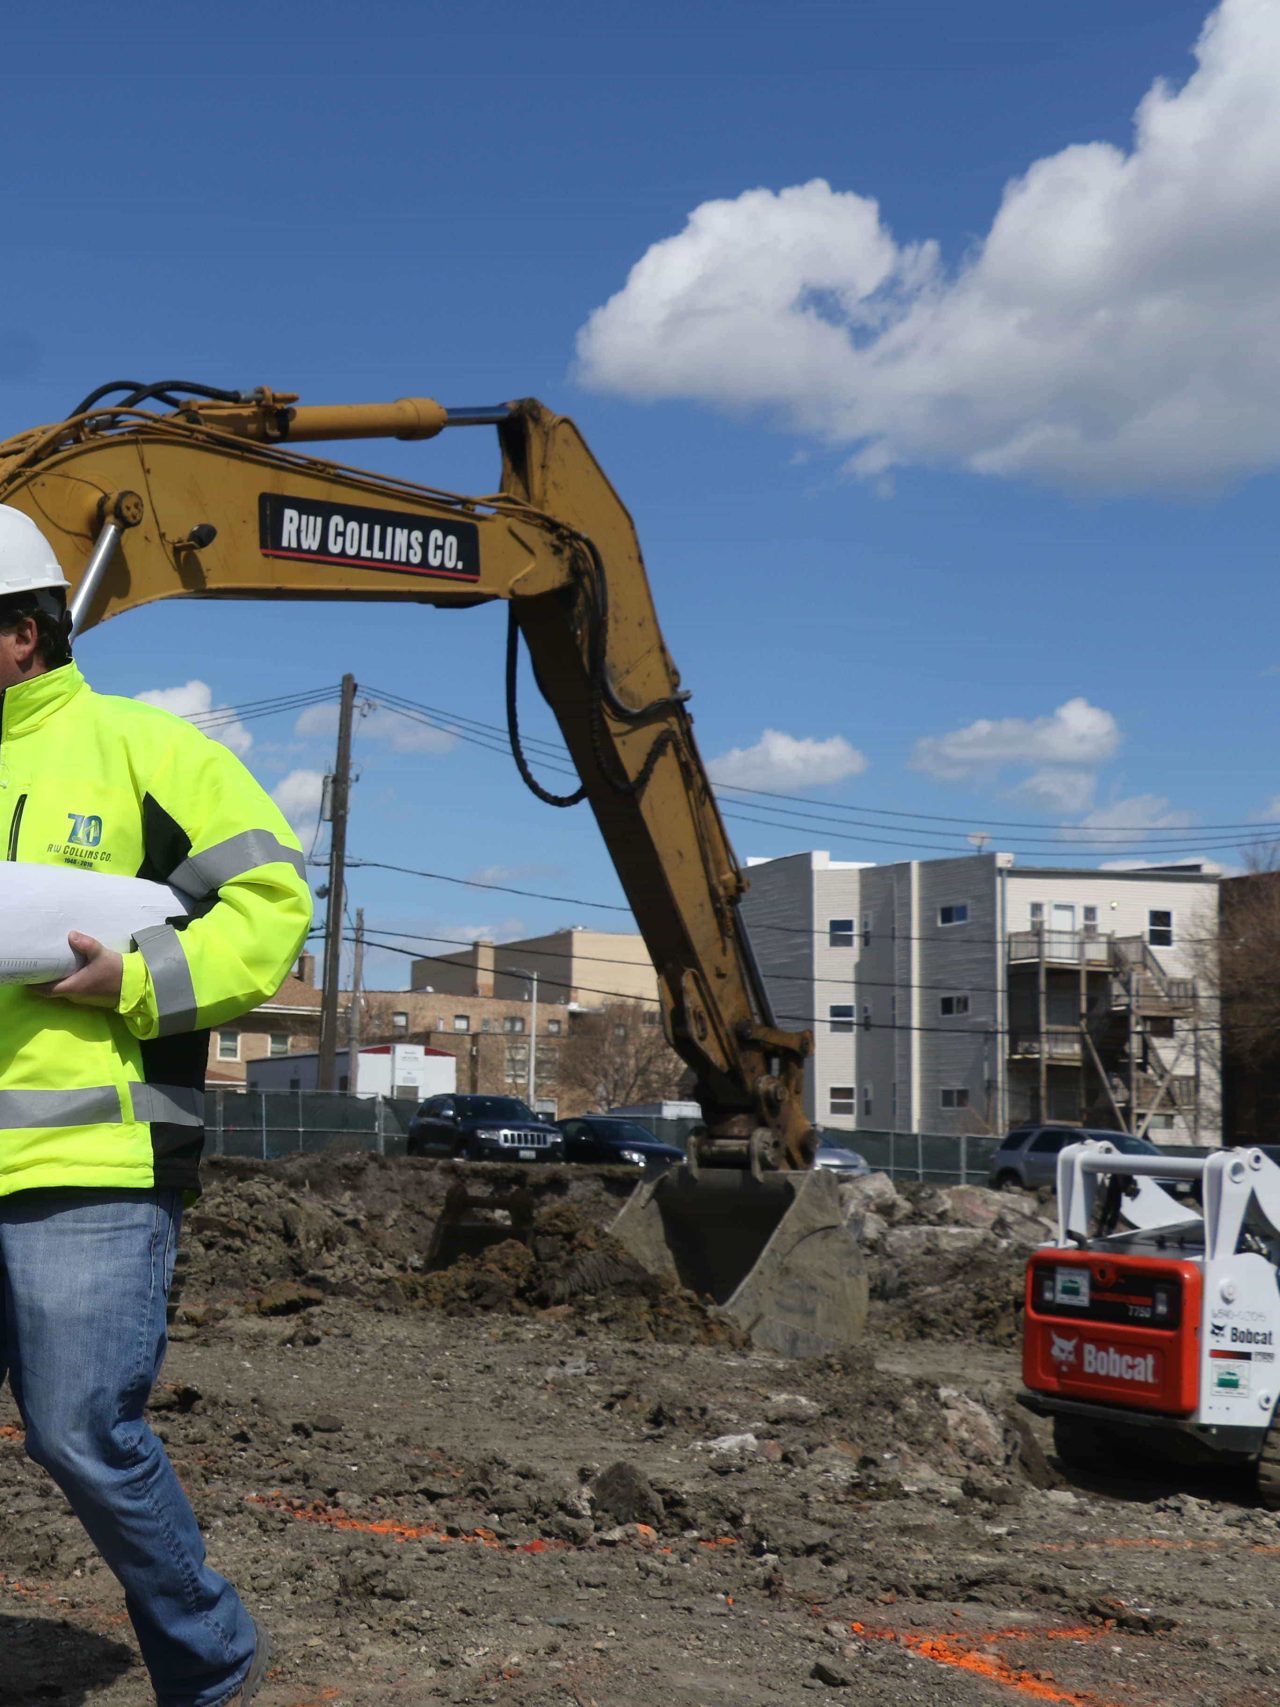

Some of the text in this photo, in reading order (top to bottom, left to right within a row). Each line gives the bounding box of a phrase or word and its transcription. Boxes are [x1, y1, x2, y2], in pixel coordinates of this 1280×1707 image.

[281, 508, 463, 570] RW COLLINS CO.
[67, 813, 103, 847] 70
[46, 843, 112, 863] RW COLLINS CO.
[1230, 1326, 1273, 1346] Bobcat
[1083, 1343, 1156, 1384] Bobcat
